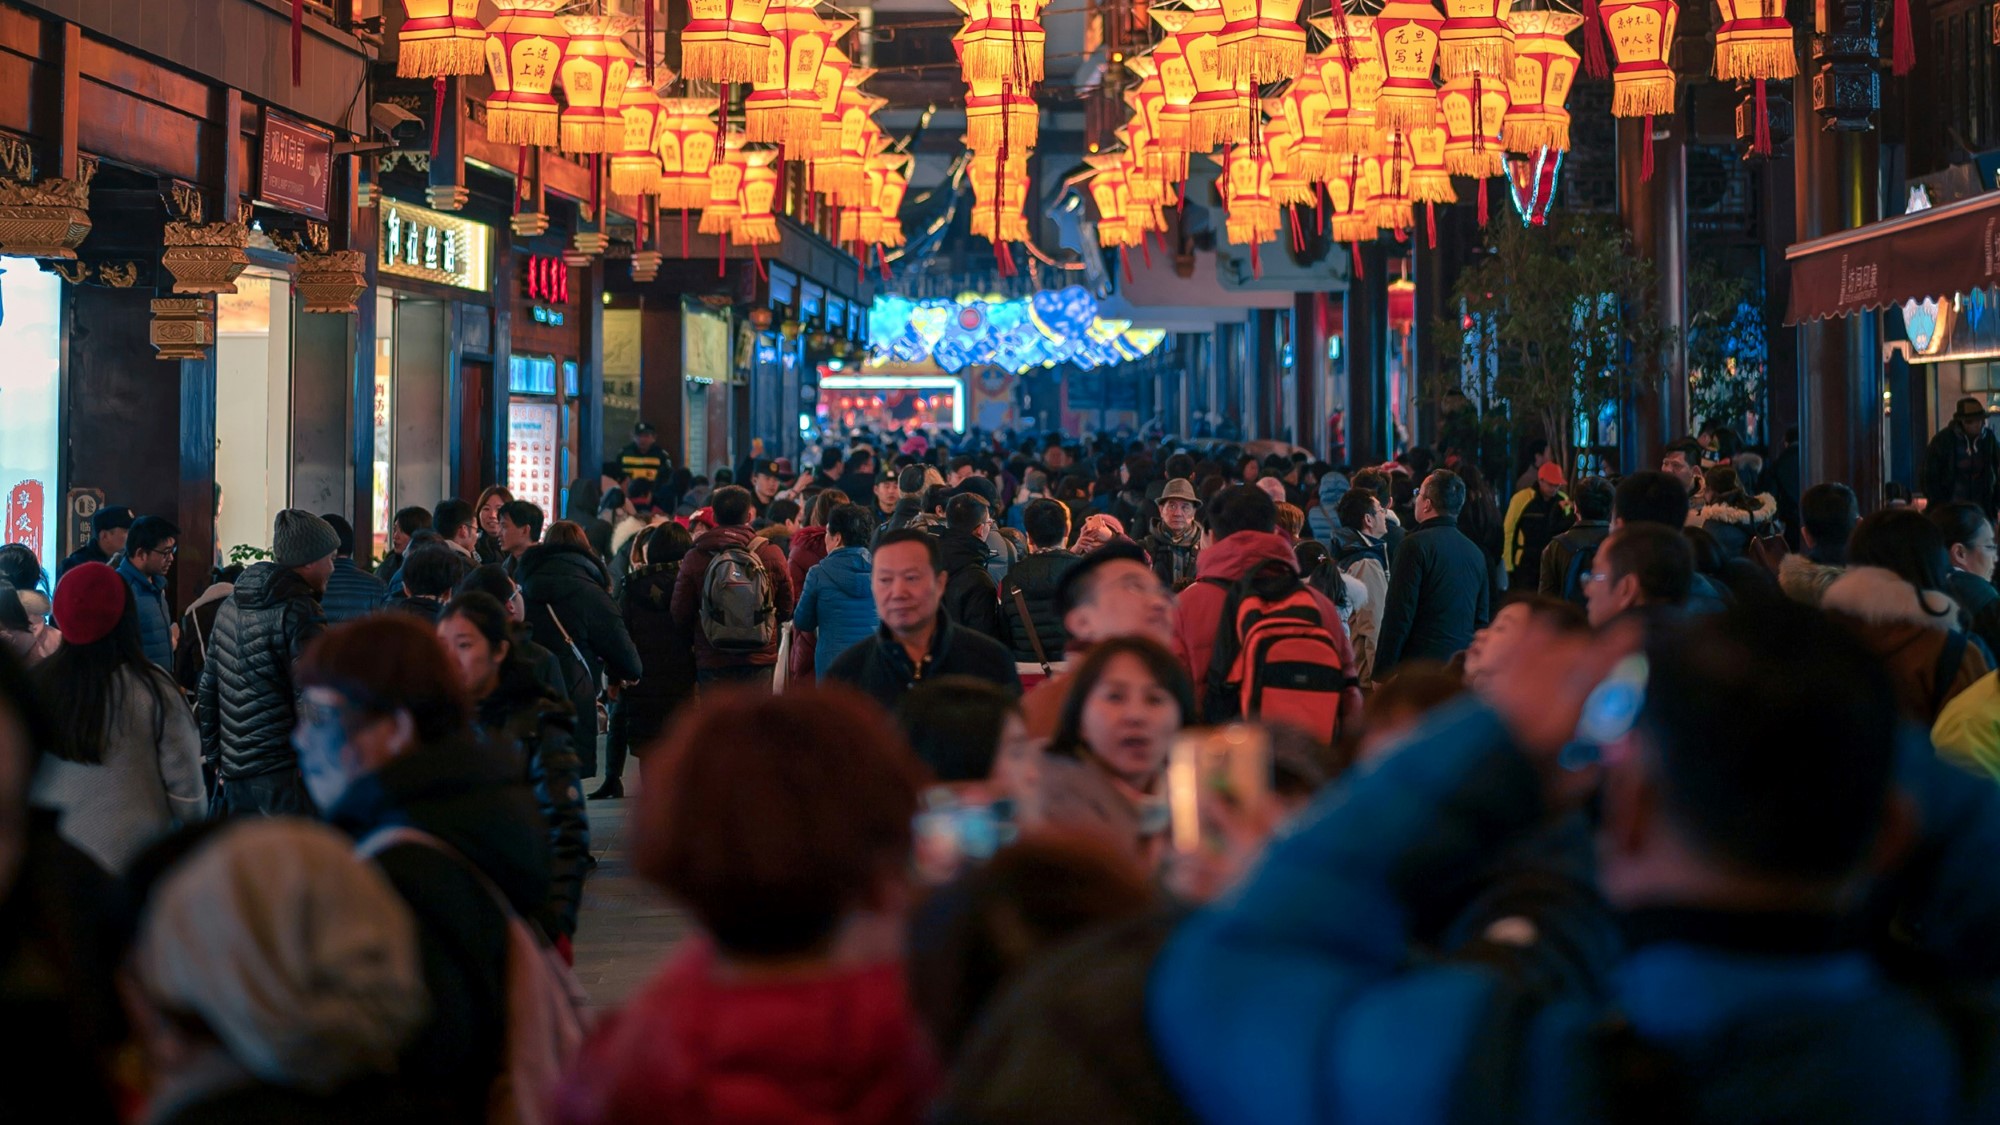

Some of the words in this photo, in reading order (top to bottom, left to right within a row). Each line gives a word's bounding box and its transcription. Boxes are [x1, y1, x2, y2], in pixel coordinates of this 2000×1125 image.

[1395, 29, 1426, 45] 元旦
[522, 46, 548, 61] 二进
[1395, 48, 1424, 63] 写生
[520, 63, 545, 79] 上海
[80, 521, 91, 547] 临时
